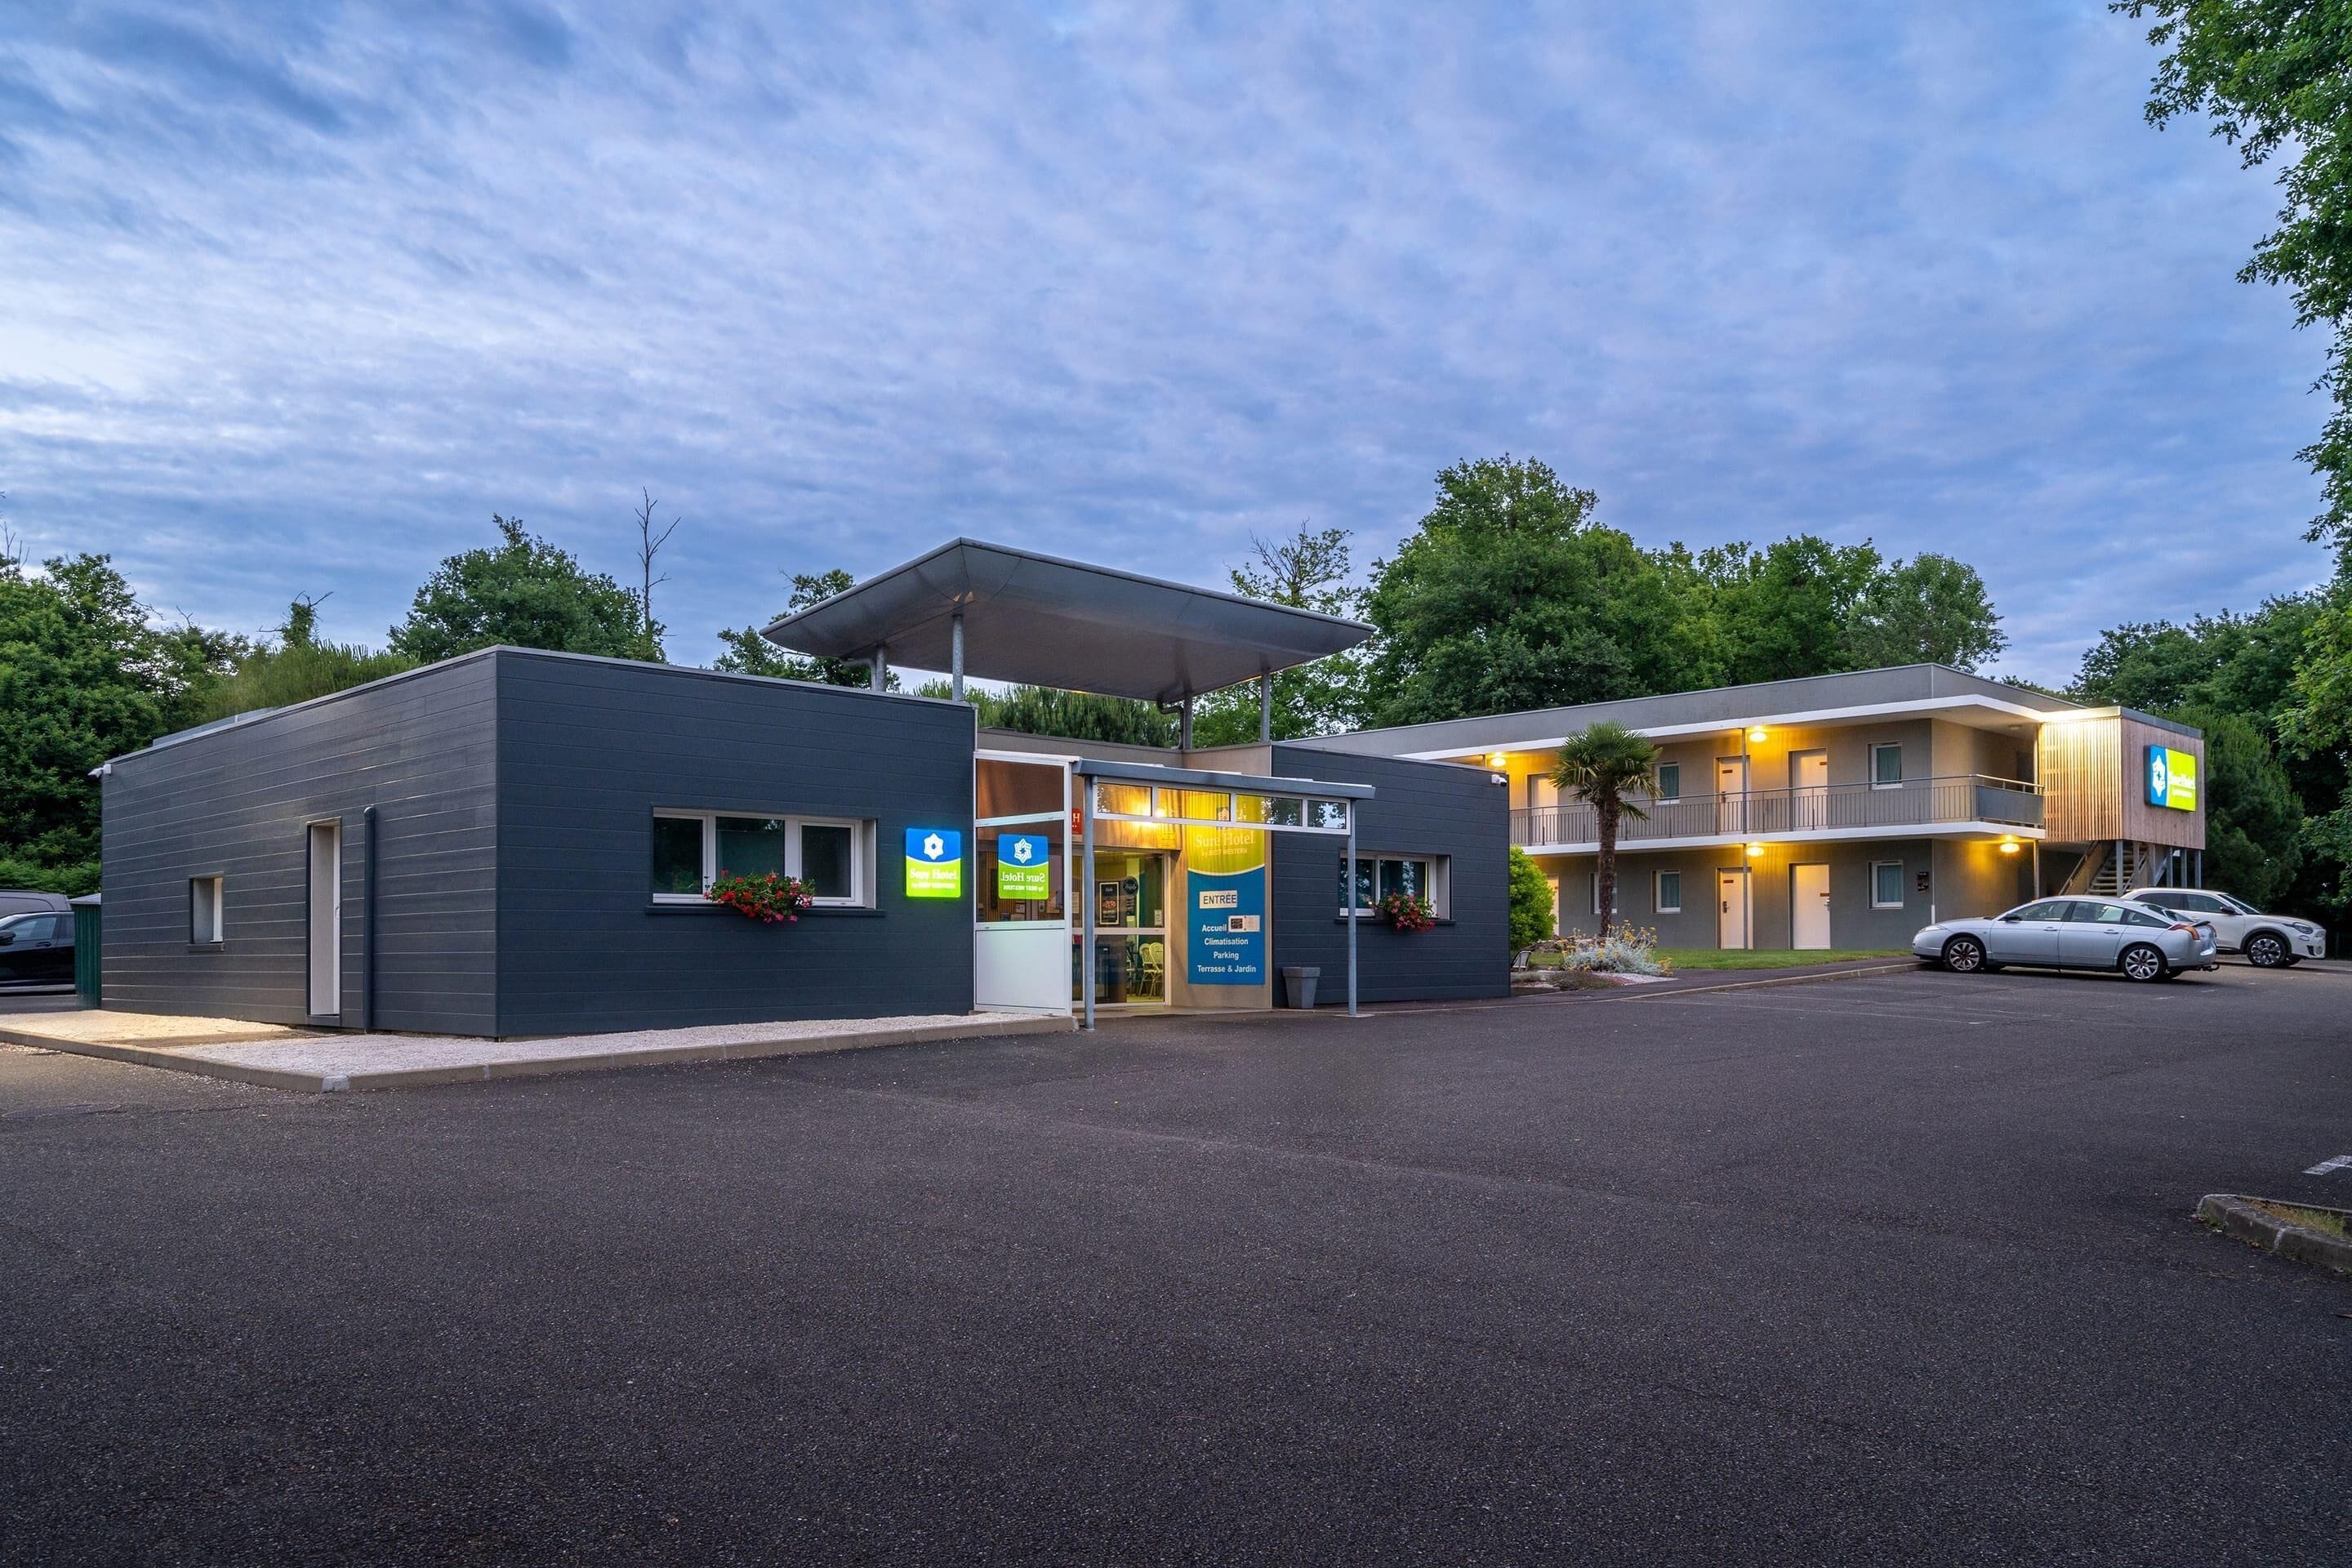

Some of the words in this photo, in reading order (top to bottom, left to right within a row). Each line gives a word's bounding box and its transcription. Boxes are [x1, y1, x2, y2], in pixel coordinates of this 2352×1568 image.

[1072, 813, 1080, 822] H
[1196, 835, 1221, 848] Sure
[1203, 893, 1236, 905] ENTRÉE
[1213, 951, 1239, 960] Parking
